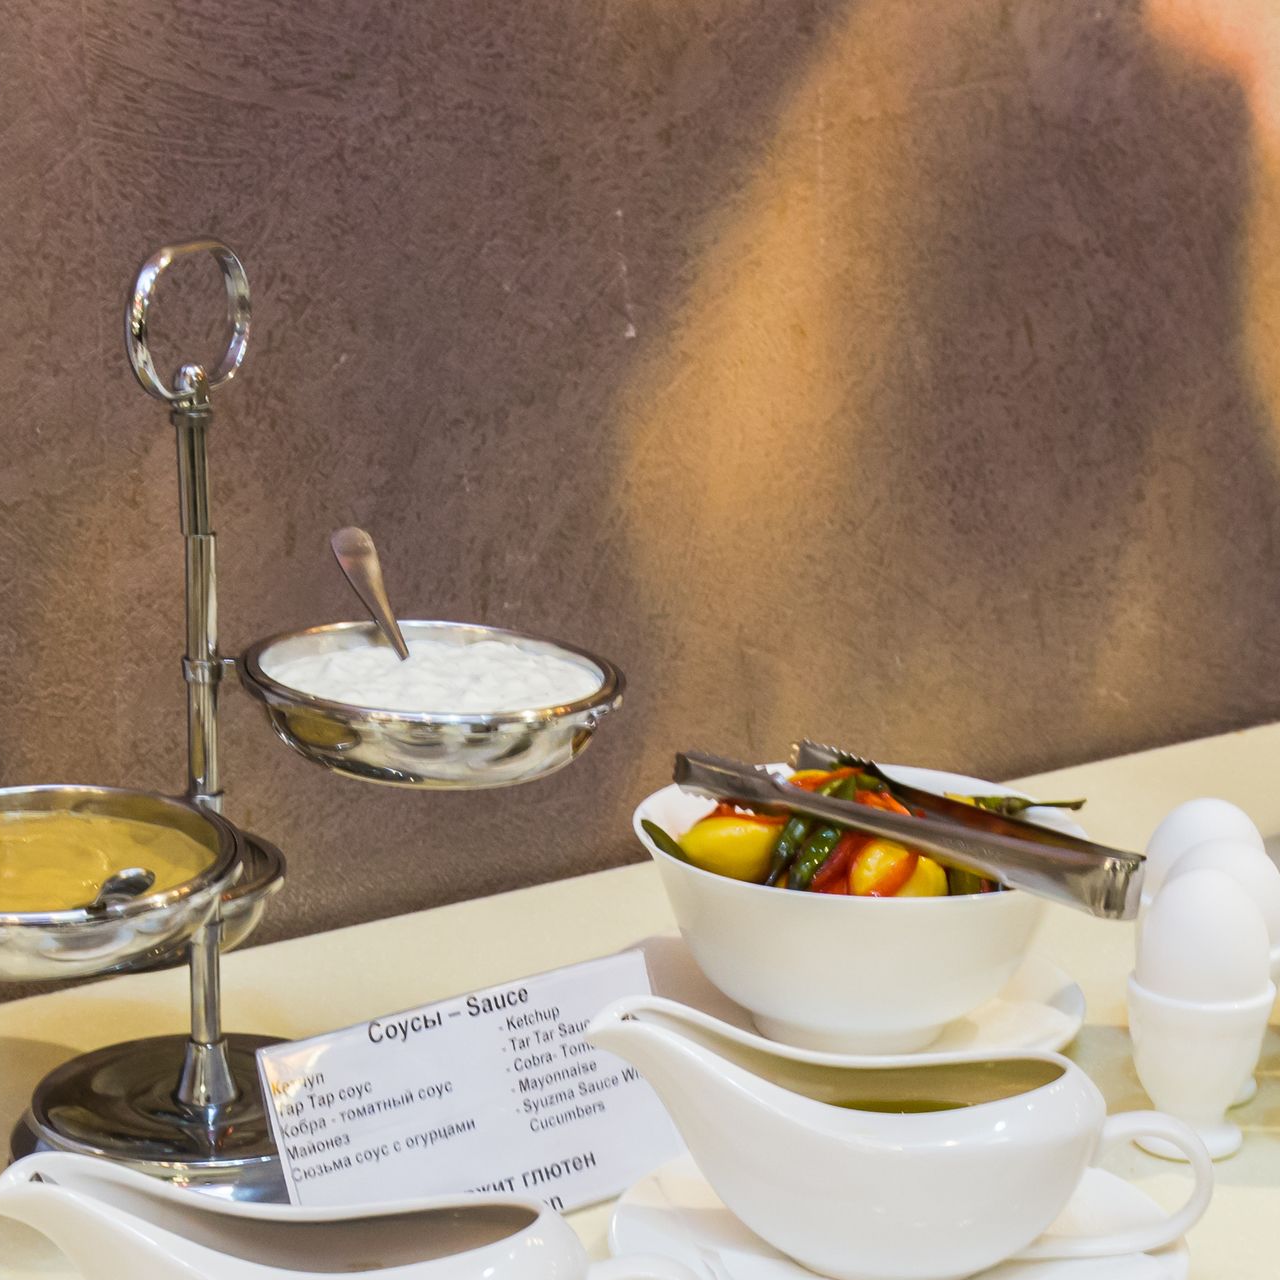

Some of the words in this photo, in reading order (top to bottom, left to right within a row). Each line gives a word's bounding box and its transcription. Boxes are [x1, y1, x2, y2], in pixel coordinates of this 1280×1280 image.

[368, 1010, 443, 1044] Соусы
[466, 987, 529, 1018] Sauce
[506, 1006, 561, 1032] Ketchup
[509, 1035, 531, 1053] Tar
[535, 1030, 555, 1044] Tar
[558, 1018, 591, 1038] Sauc
[307, 1090, 336, 1110] Тар
[338, 1080, 373, 1103] соус
[518, 1061, 598, 1094] Mayonnaise
[523, 1087, 575, 1114] Syuzma
[578, 1074, 619, 1096] Sauce
[621, 1066, 643, 1083] Wi
[280, 1117, 328, 1140] Кобра
[340, 1090, 415, 1124] томатный
[418, 1079, 454, 1102] соус
[529, 1099, 606, 1133] Cucumbers
[285, 1132, 352, 1162] Майонез
[291, 1154, 353, 1184] Сюзьма
[355, 1142, 391, 1165] соус
[406, 1117, 477, 1150] огурцами
[521, 1150, 597, 1189] глютен
